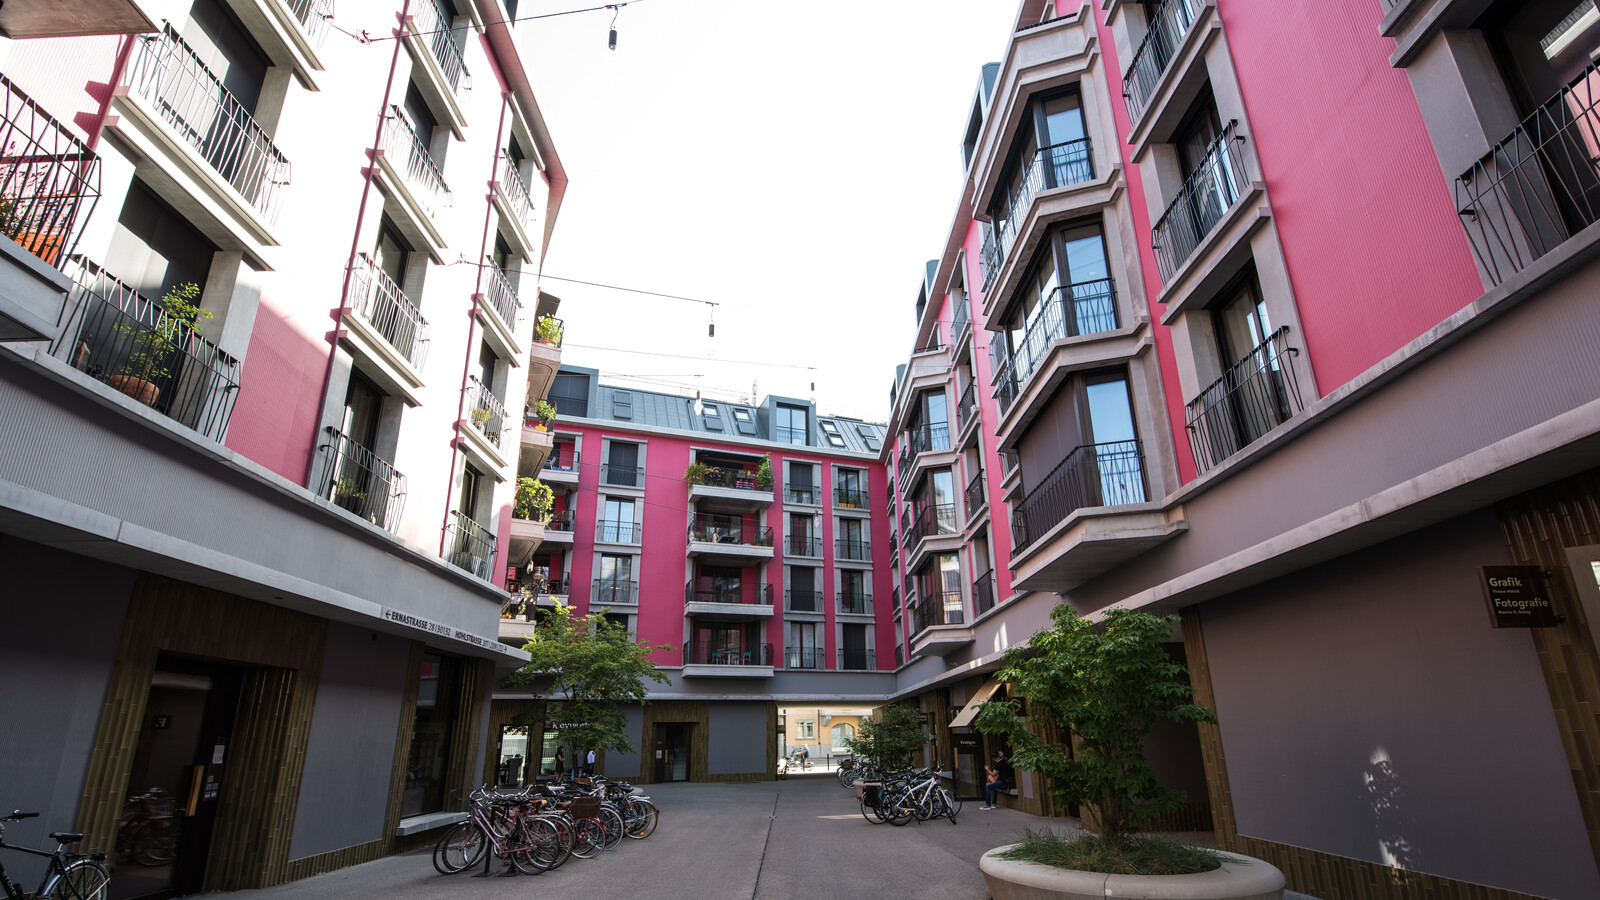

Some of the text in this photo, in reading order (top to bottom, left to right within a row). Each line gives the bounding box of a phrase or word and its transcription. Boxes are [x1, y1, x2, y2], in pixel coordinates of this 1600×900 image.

[1489, 577, 1522, 587] Grafik
[1494, 597, 1548, 610] Fotografie
[391, 611, 428, 630] ERNASTRASSE
[455, 630, 482, 646] HOHLSTRASSE
